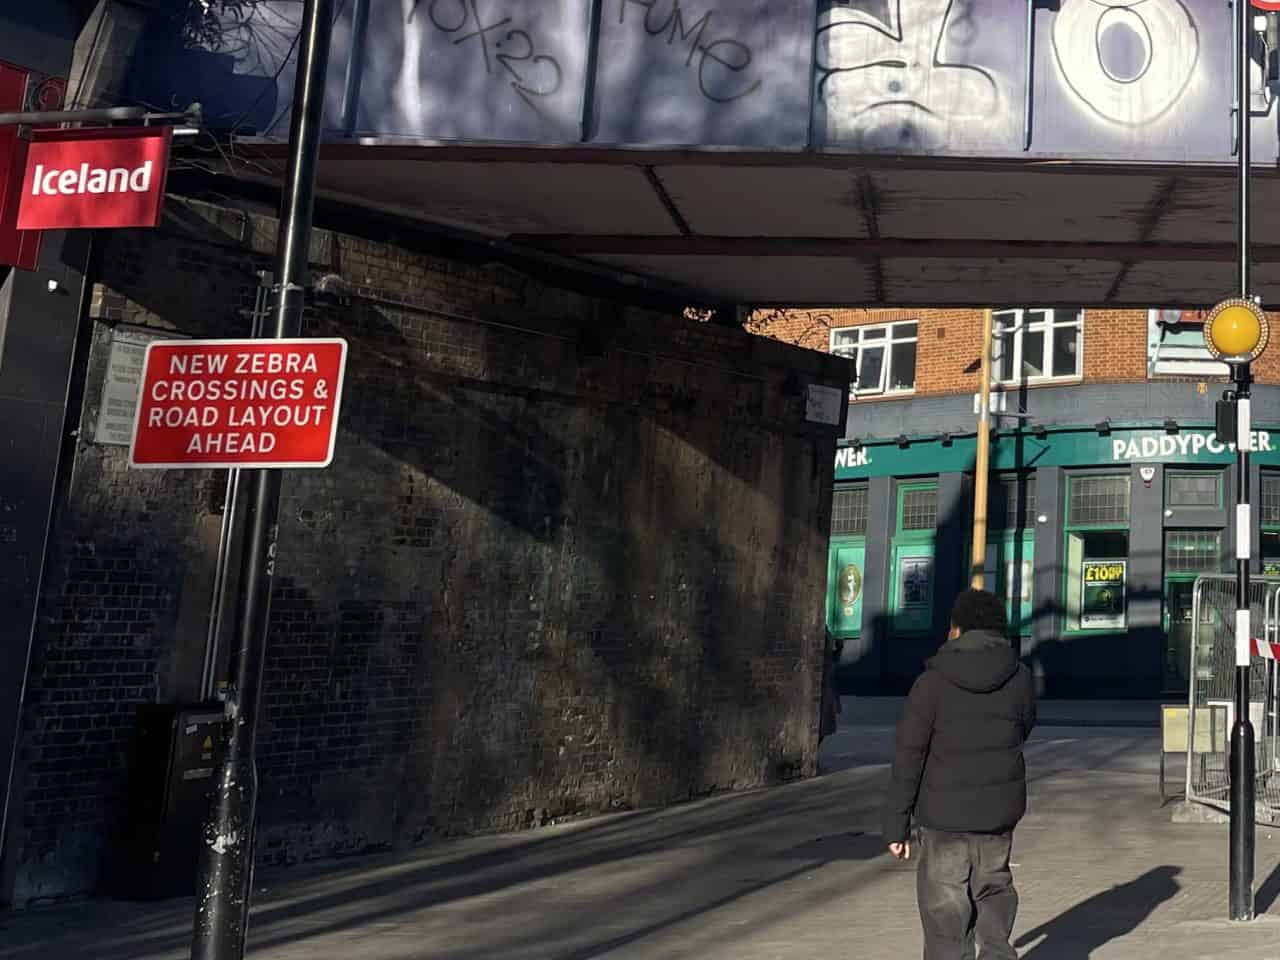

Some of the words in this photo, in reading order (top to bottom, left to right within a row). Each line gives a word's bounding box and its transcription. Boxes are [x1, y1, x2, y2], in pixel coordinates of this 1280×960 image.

[31, 160, 153, 196] Iceland
[169, 354, 228, 374] NEW
[235, 352, 318, 374] ZEBRA
[151, 379, 304, 401] CROSSINGS
[313, 380, 328, 400] &
[148, 406, 219, 428] ROAD
[228, 404, 327, 426] LAYOUT
[186, 433, 277, 454] AHEAD
